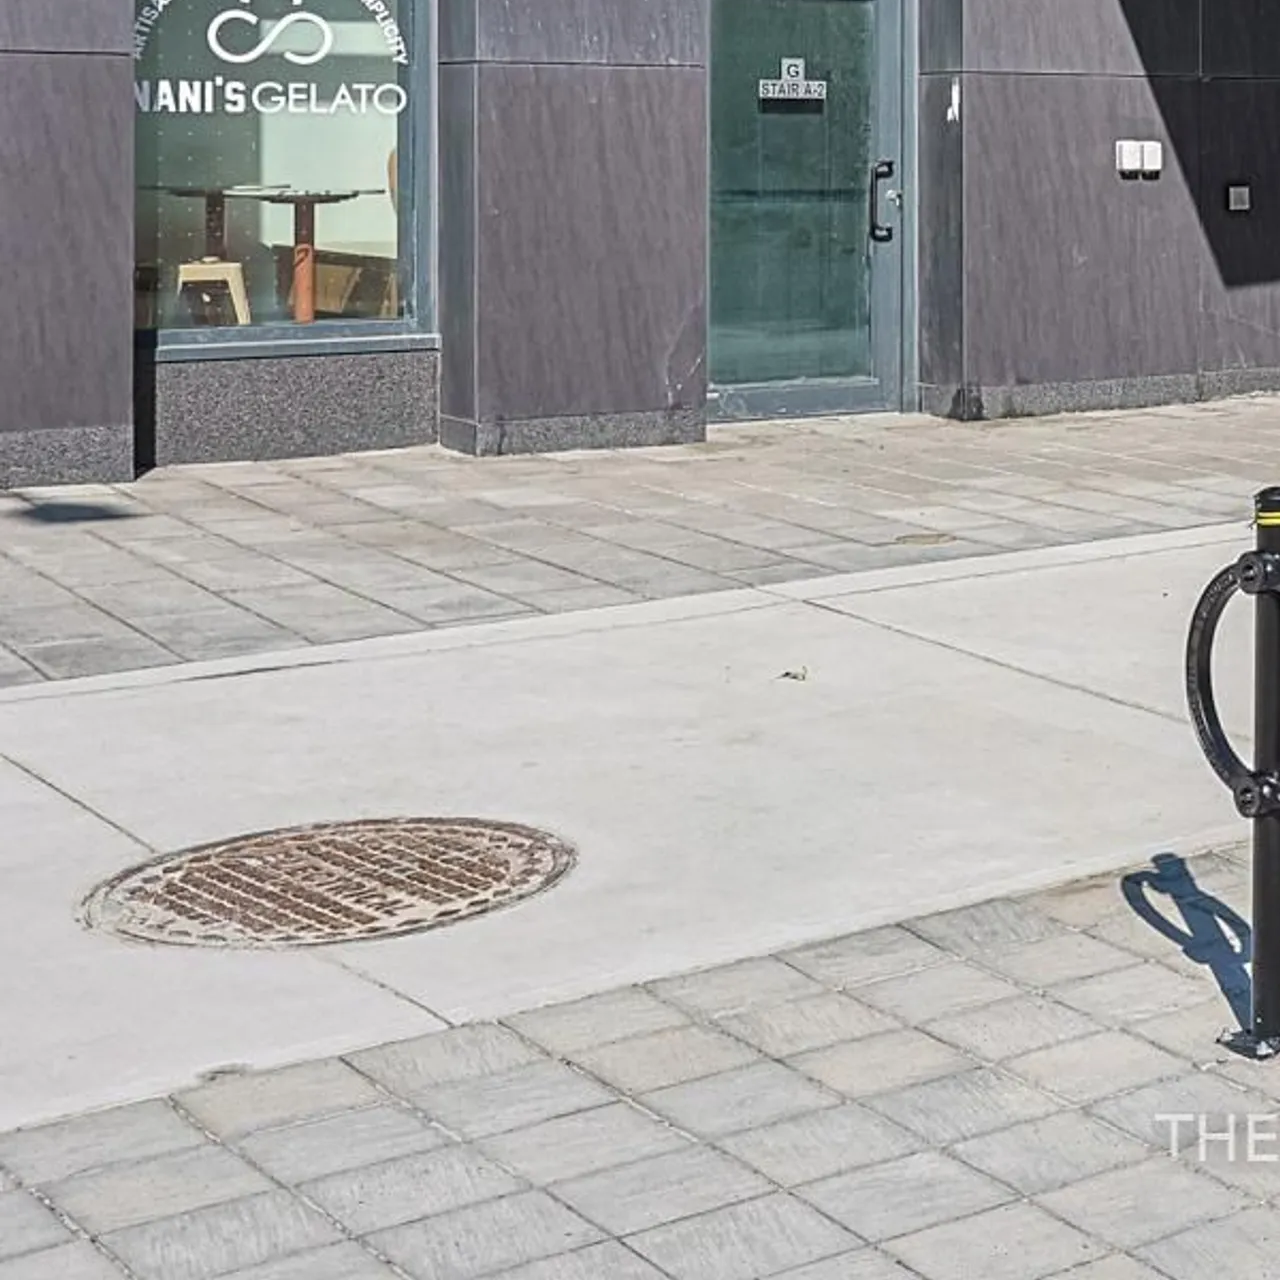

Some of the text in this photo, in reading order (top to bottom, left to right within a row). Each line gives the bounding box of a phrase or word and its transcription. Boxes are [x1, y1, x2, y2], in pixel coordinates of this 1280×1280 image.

[787, 64, 800, 78] G
[251, 81, 408, 114] GELATO
[761, 82, 826, 98] STAIR A-2
